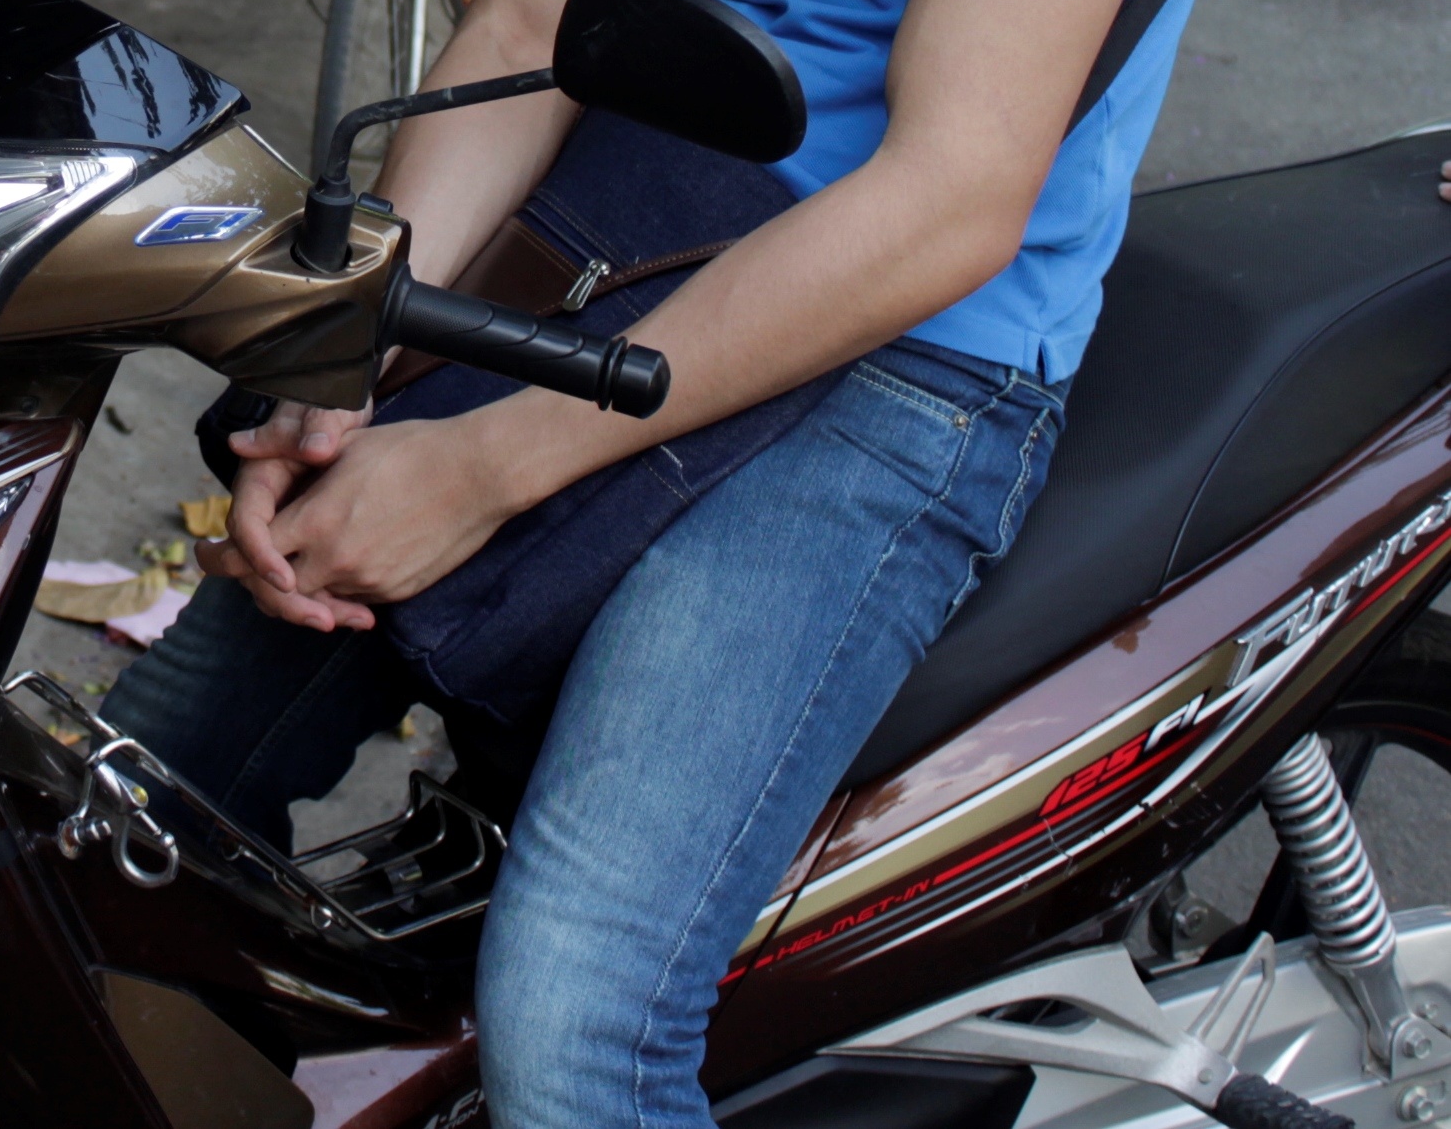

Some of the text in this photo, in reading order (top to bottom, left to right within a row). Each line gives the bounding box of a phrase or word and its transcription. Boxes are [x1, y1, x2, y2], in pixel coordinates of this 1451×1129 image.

[155, 212, 250, 231] FI
[1039, 693, 1206, 817] 125 FI
[777, 878, 930, 960] HELMET-IN
